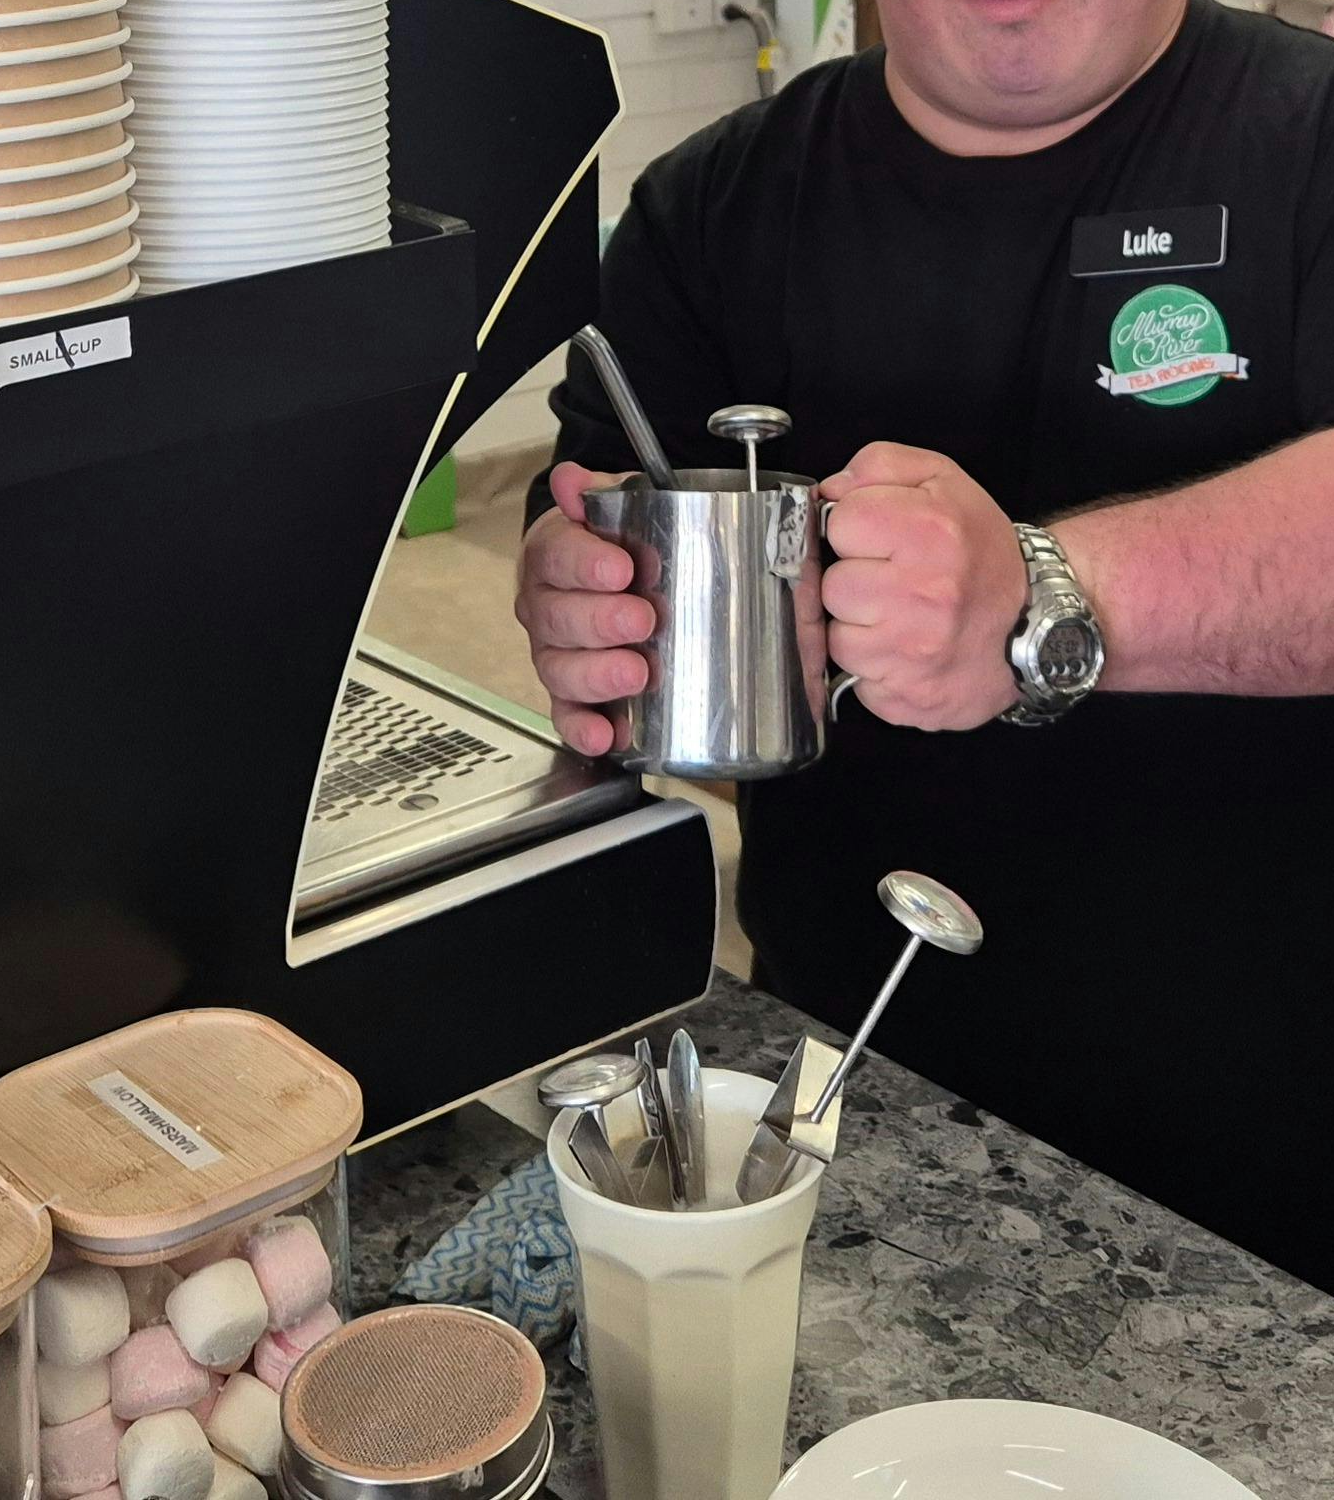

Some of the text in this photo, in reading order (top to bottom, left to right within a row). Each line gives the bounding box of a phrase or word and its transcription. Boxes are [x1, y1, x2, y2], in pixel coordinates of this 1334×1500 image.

[1122, 226, 1173, 257] Luke
[1117, 304, 1209, 345] Murray
[9, 338, 101, 369] SMALL CUP
[1133, 332, 1203, 367] River
[1127, 358, 1215, 389] TEA ROOMS
[110, 1086, 199, 1155] MARSHMALLOW
